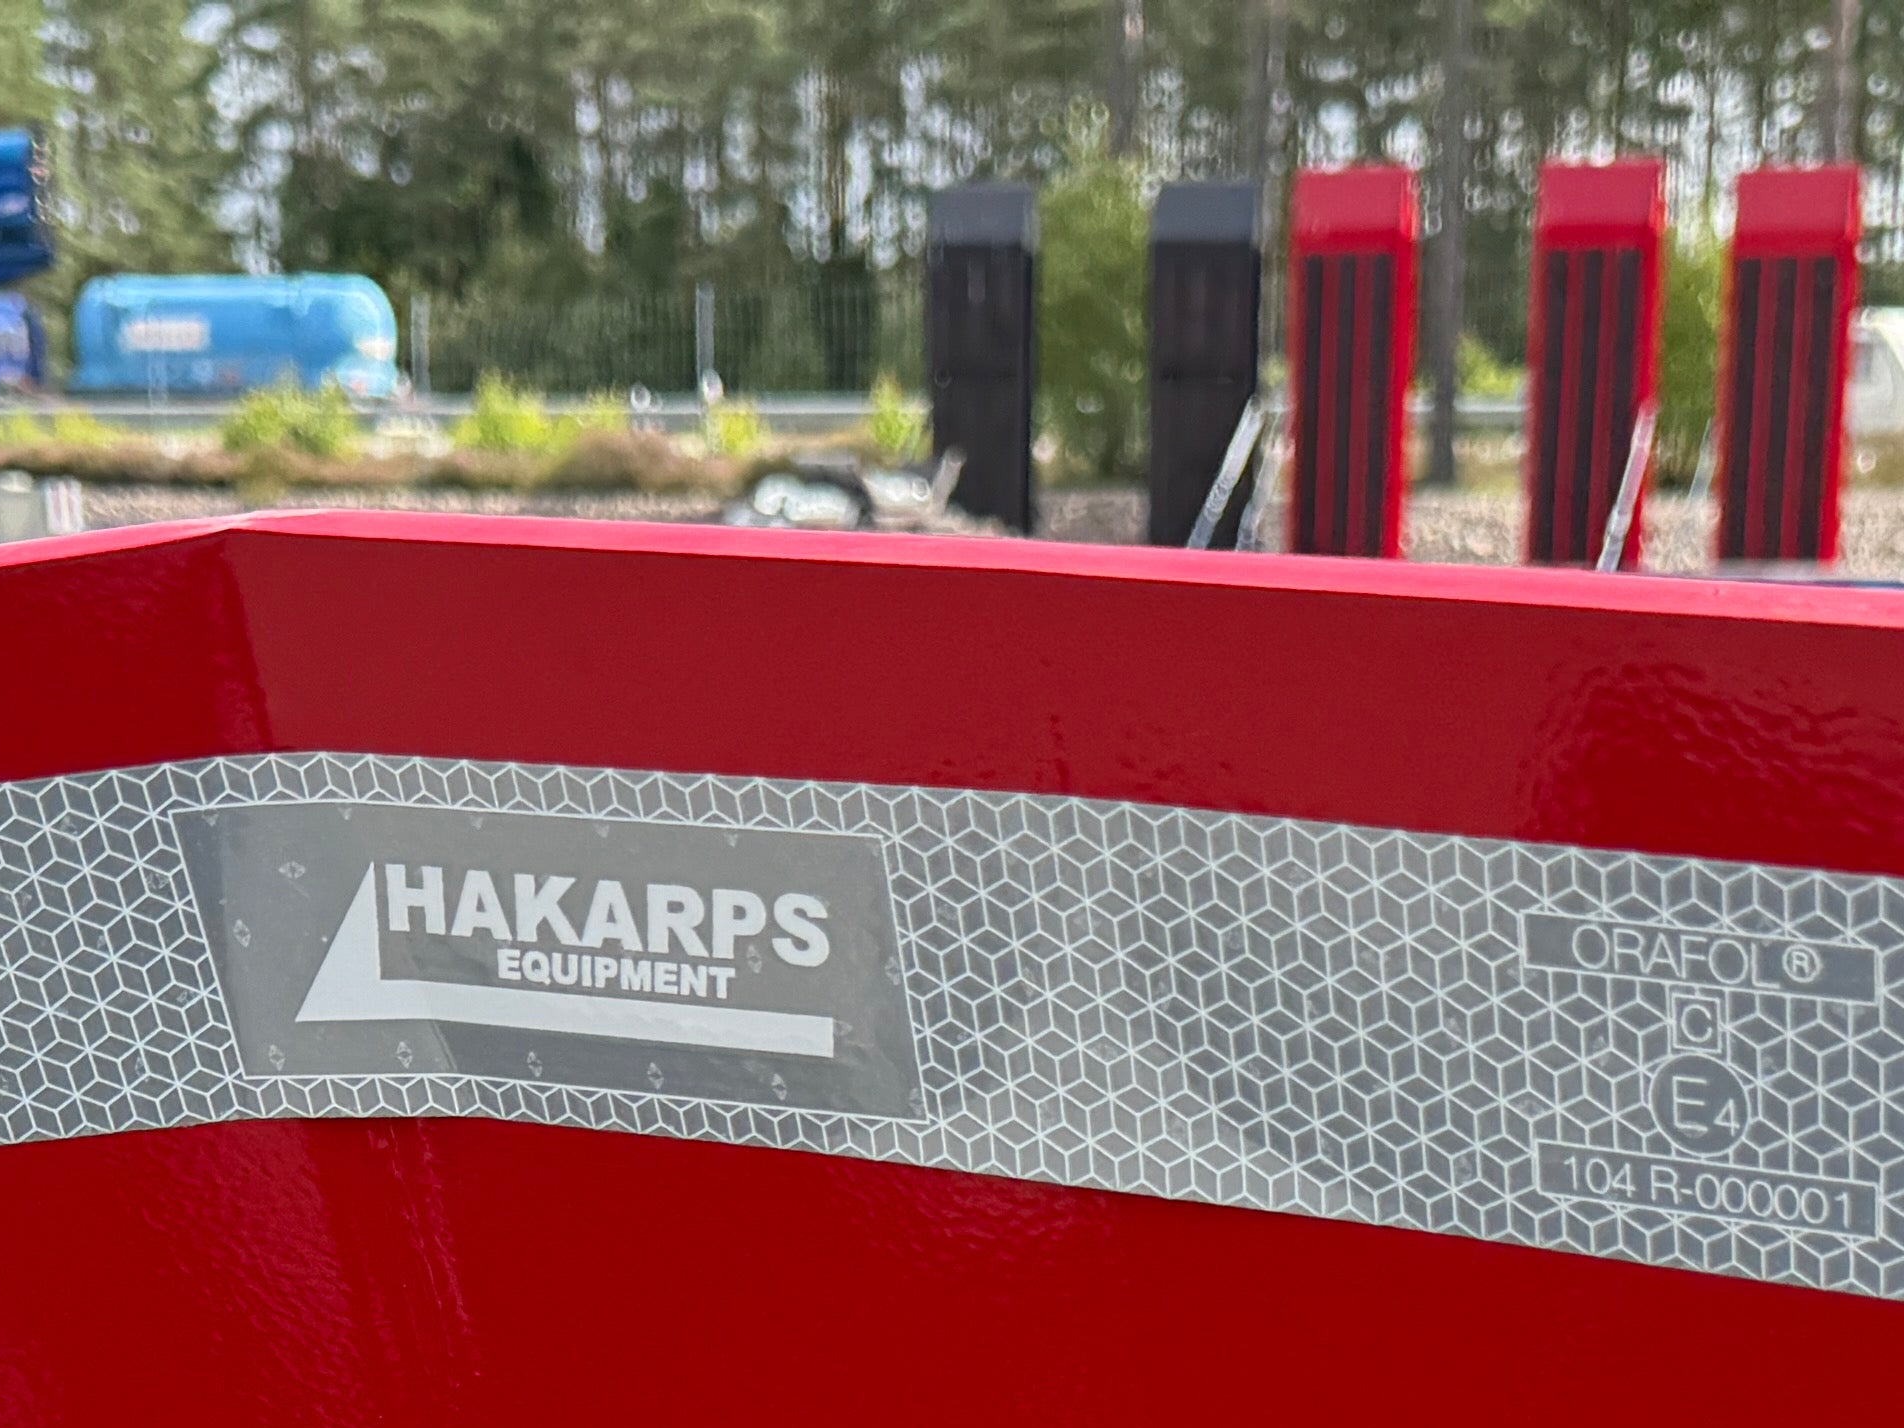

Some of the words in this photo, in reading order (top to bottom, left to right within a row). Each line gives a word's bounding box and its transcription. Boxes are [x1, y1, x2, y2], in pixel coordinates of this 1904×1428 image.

[385, 863, 831, 968] HAKARPS
[496, 948, 736, 999] EQUIPMENT
[1564, 1156, 1636, 1198] 104
[1651, 1166, 1851, 1229] R-000001
